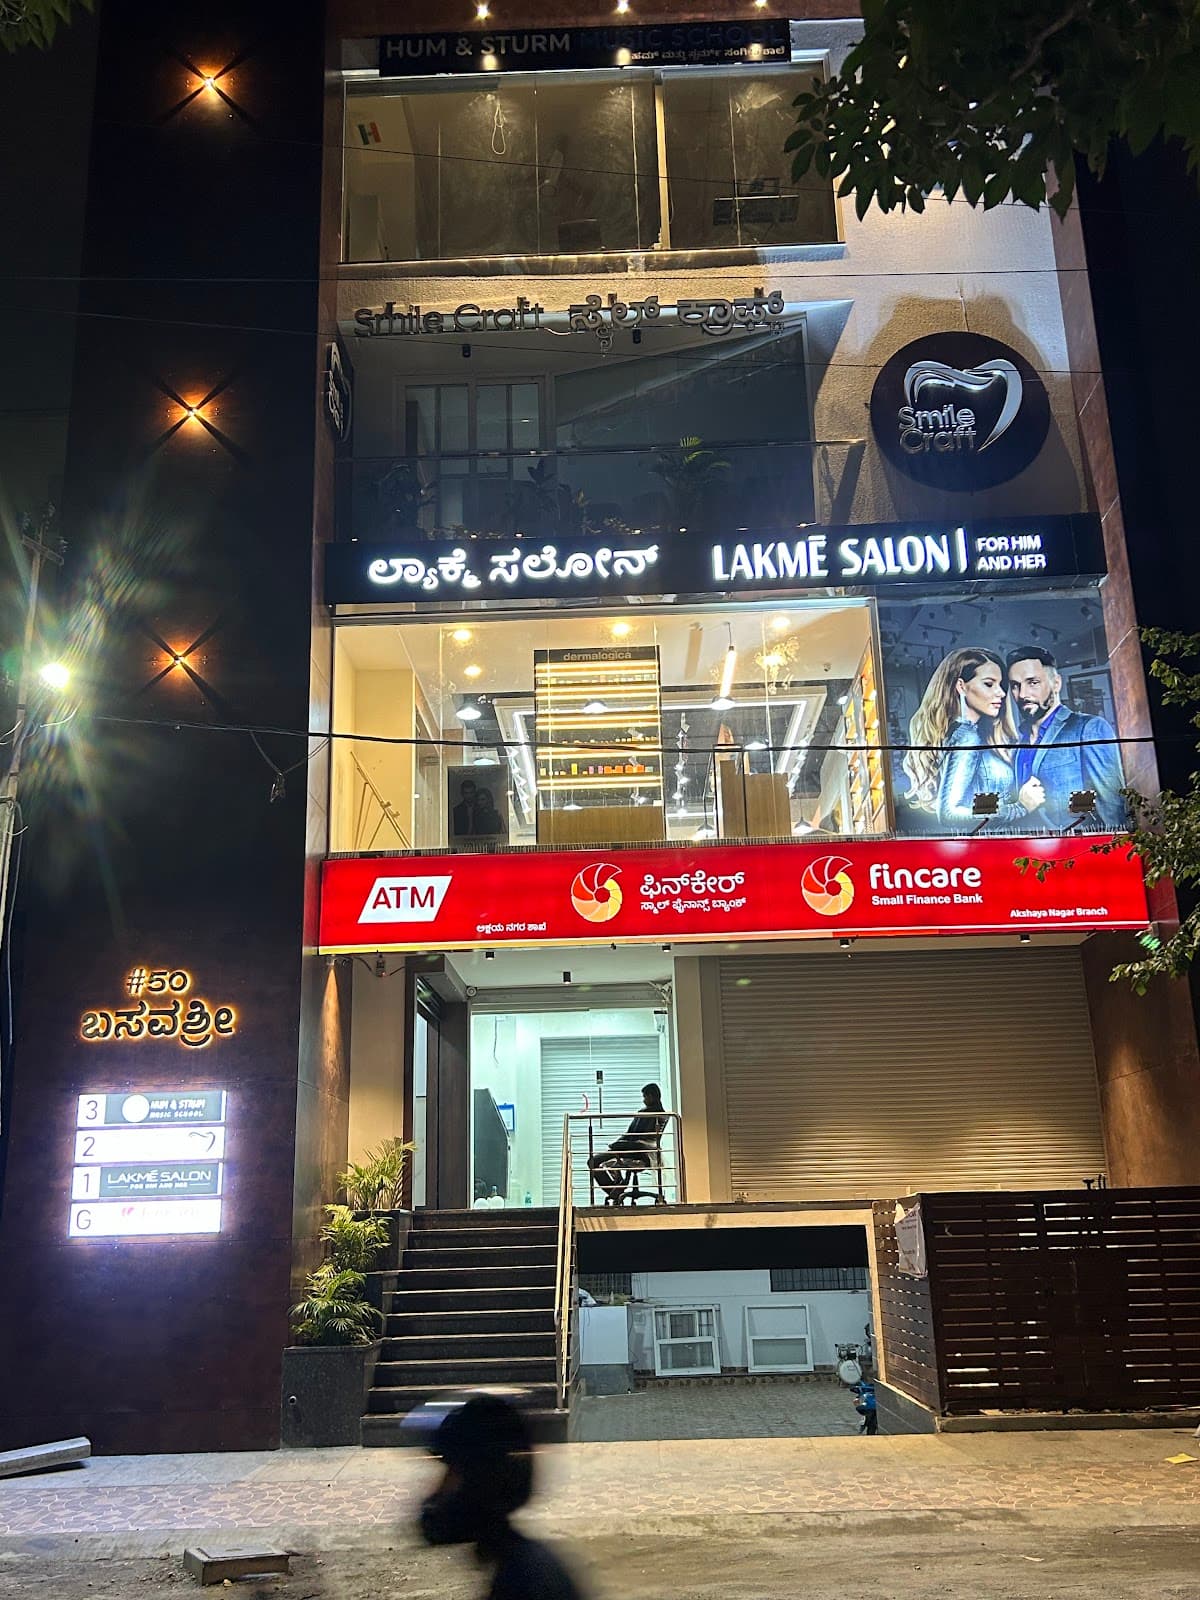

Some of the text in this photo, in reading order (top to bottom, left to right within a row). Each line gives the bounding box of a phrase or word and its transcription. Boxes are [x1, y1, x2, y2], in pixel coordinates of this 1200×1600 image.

[386, 24, 785, 58] HUM & STURM MUSIC SCHOOL
[354, 298, 545, 336] Smile Craft
[898, 404, 976, 429] Smile
[899, 426, 976, 453] Craft
[976, 535, 1043, 552] FOR HIM
[489, 545, 660, 583] ಸಲೋನ್
[841, 534, 951, 577] SALON
[977, 554, 1047, 571] AND HER
[563, 650, 633, 661] dermalogica
[869, 863, 982, 890] fincare
[372, 886, 435, 910] ATM
[711, 897, 747, 912] ಬ್ಯಾಂಕ್
[871, 892, 984, 906] Small Finance Bank
[1010, 906, 1108, 918] Akshaya Nagar Branch
[505, 923, 526, 932] ನಗರ
[126, 968, 190, 995] #50
[81, 1000, 234, 1047] ಬಸವಶ್ರೀ
[85, 1100, 98, 1120] 3
[82, 1136, 95, 1157] 2
[83, 1173, 89, 1193] 1
[160, 1170, 212, 1182] SALON
[76, 1209, 92, 1230] G
